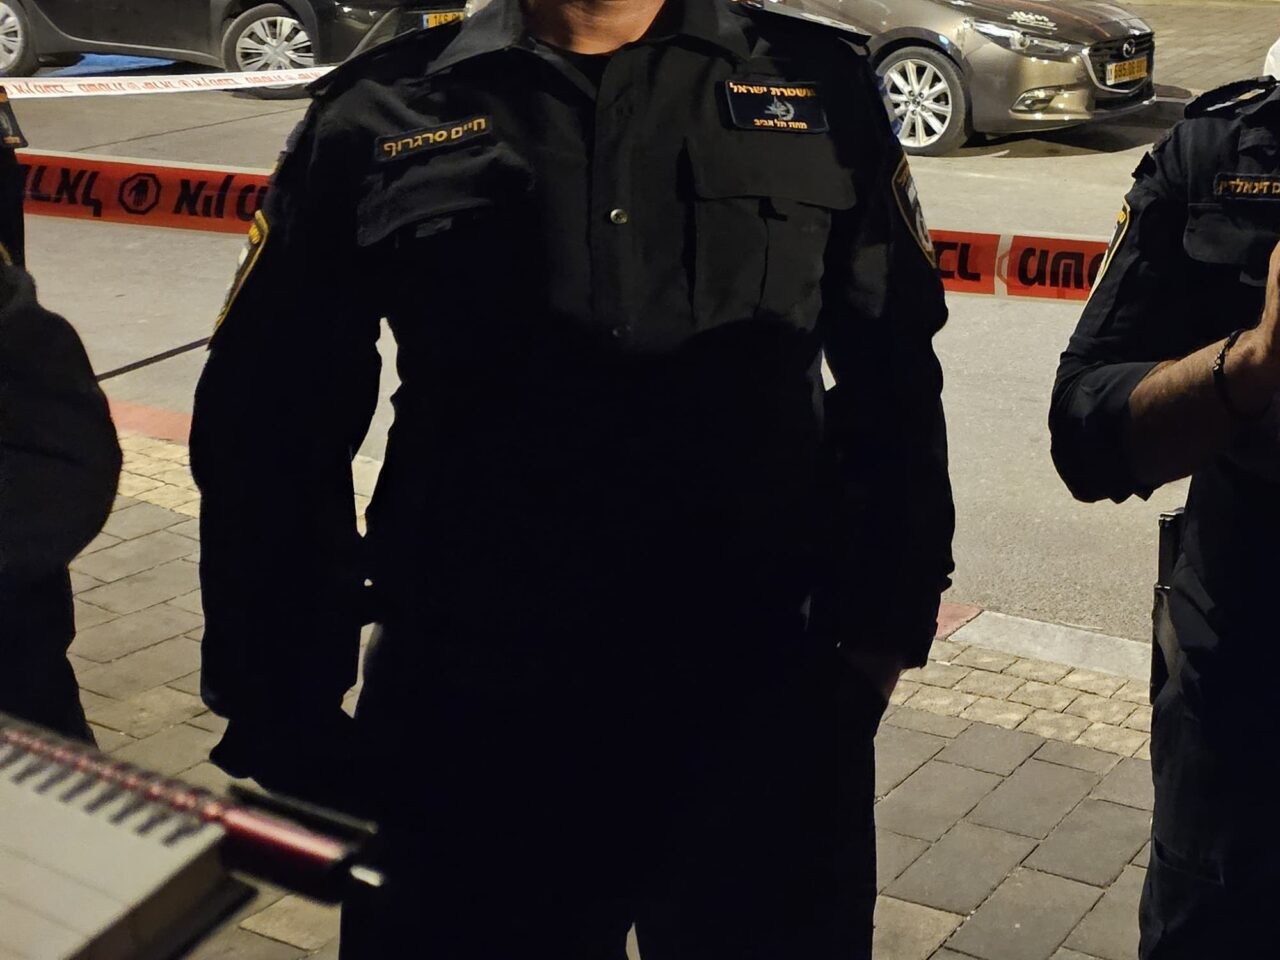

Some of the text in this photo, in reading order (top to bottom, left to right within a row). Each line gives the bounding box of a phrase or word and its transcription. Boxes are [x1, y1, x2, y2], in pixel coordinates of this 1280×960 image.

[729, 82, 767, 94] ישראל
[384, 118, 485, 157] חיים סרגרוף
[22, 163, 104, 217] ראל
[932, 240, 981, 282] בר
